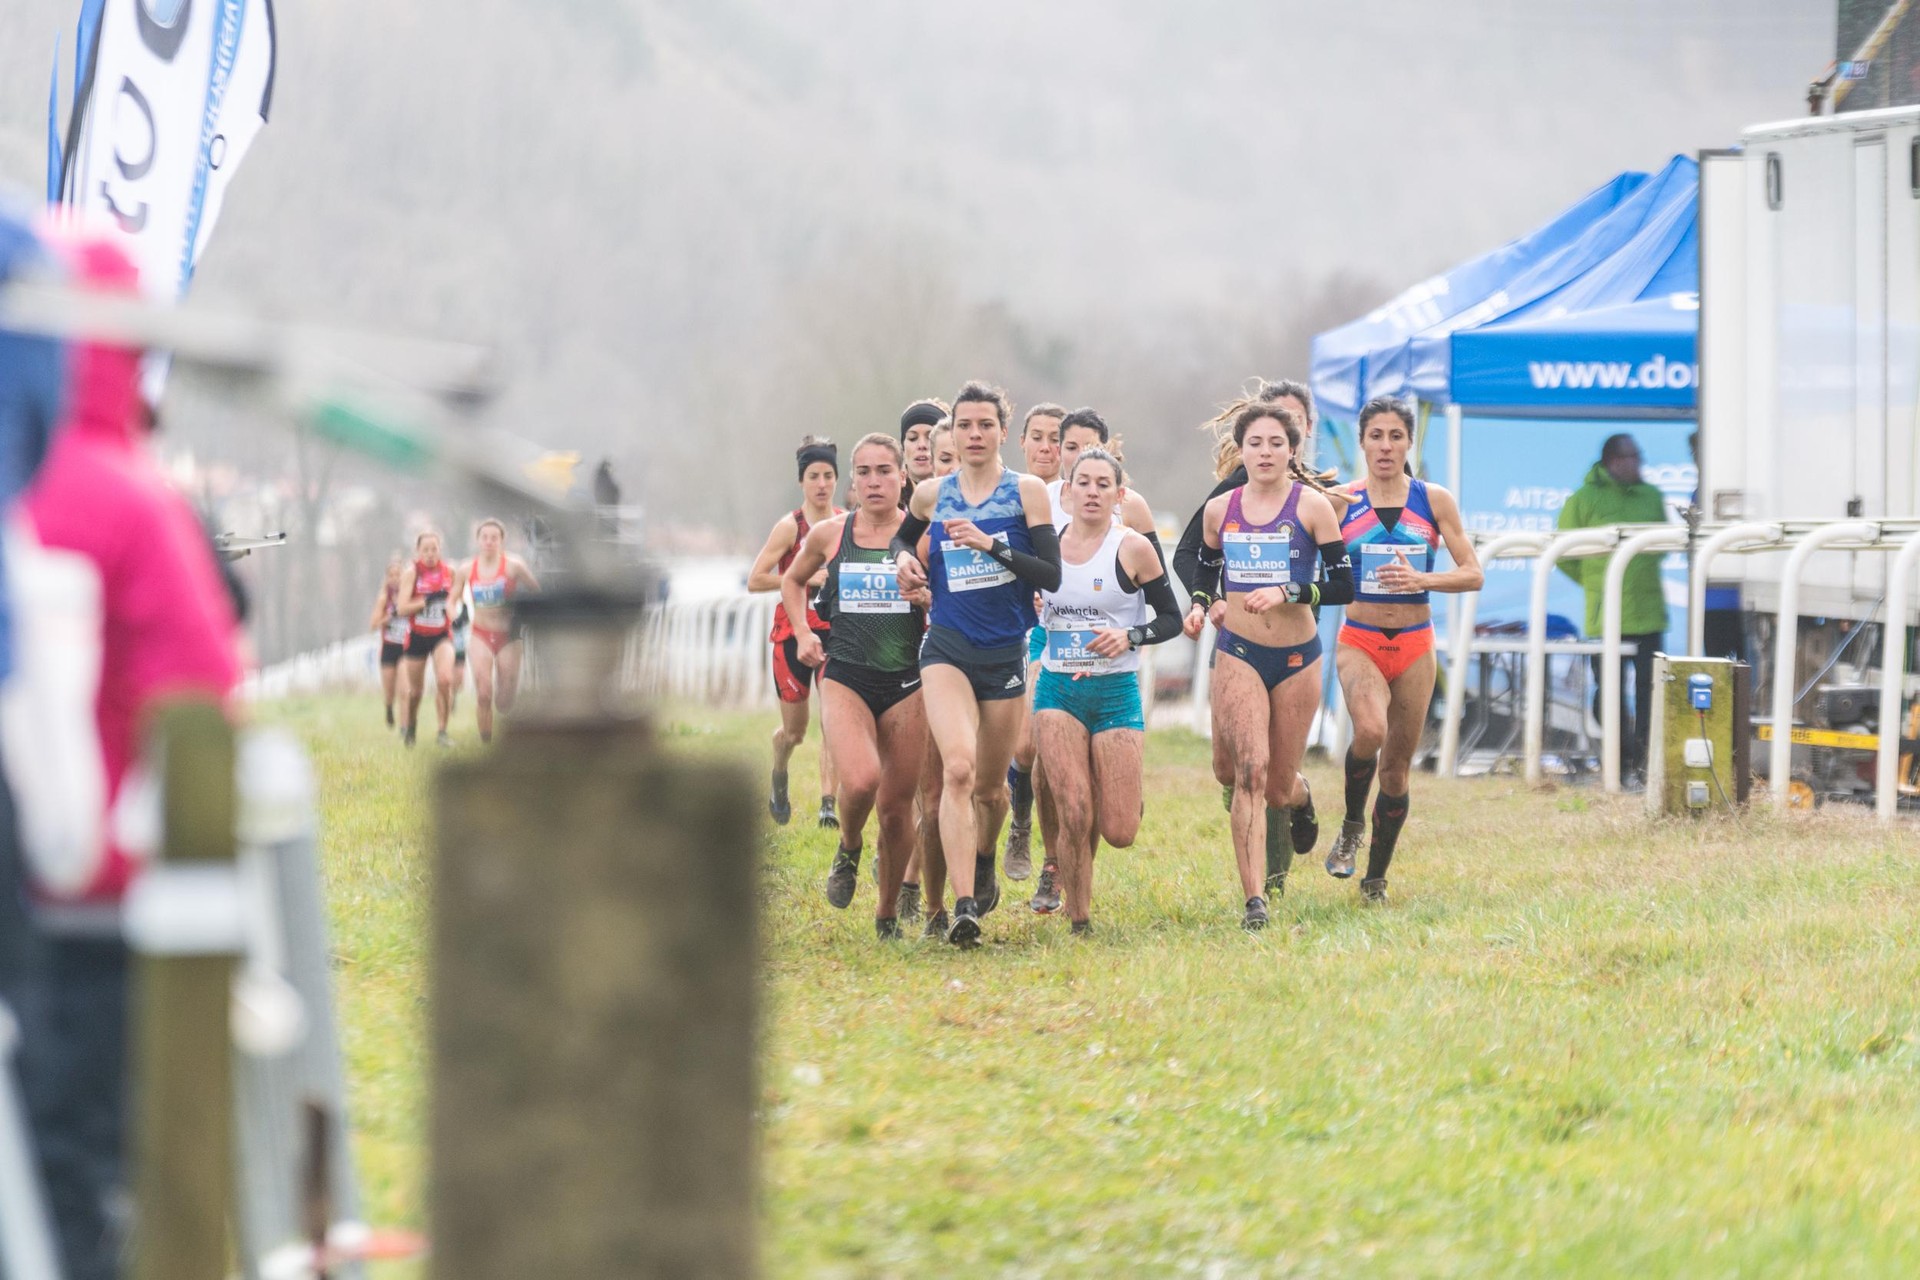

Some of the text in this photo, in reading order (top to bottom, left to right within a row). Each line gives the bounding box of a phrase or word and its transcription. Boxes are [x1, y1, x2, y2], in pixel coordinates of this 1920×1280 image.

[970, 549, 984, 564] 2
[1248, 544, 1261, 559] 9
[1228, 559, 1287, 570] GALLARDO
[862, 575, 886, 589] 10
[1052, 605, 1099, 616] València
[1070, 632, 1082, 648] 3
